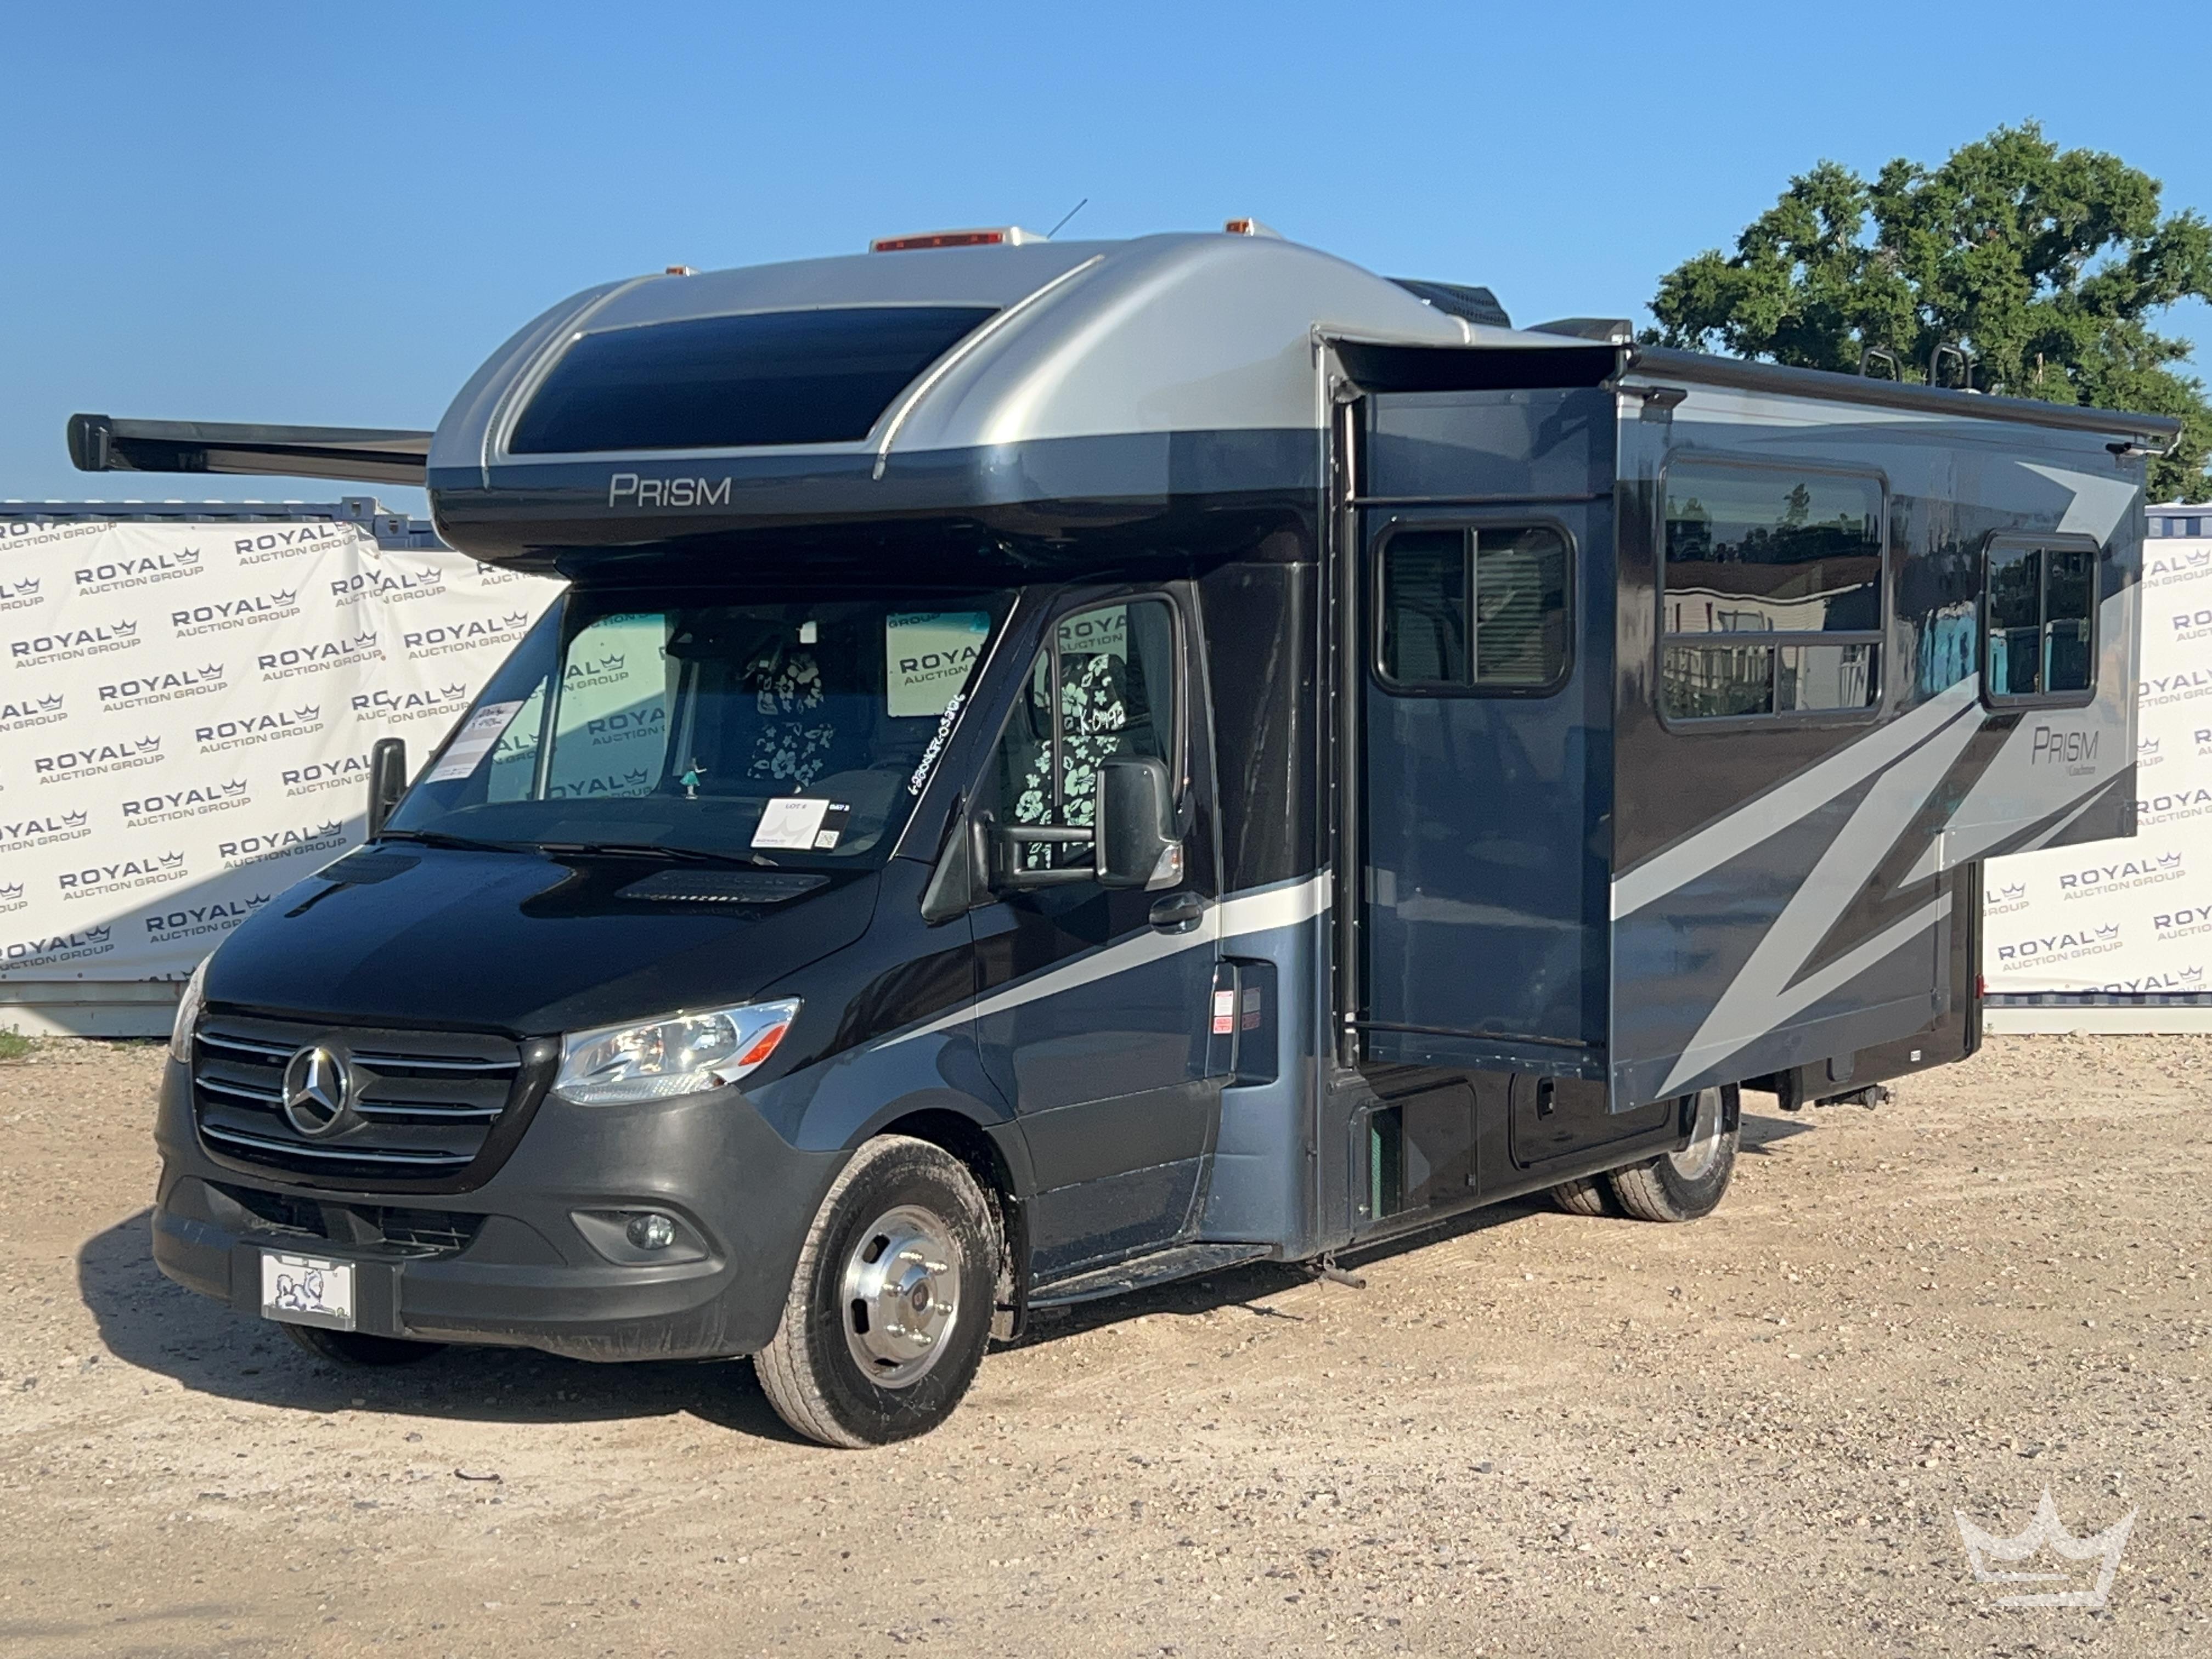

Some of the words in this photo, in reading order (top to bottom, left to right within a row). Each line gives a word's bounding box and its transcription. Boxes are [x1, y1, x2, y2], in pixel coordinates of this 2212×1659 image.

[609, 473, 732, 507] PRISM
[0, 533, 60, 551] UCTION
[64, 522, 117, 539] GROUP
[235, 525, 334, 554] ROYAL
[239, 546, 307, 566] AUCTION
[310, 535, 357, 552] GROUP
[75, 555, 174, 584] ROYAL
[80, 577, 147, 596] AUCTION
[150, 566, 204, 583] GROUP
[331, 569, 416, 596] ROYAL
[481, 572, 525, 586] AUCT
[0, 596, 44, 611] ROUP
[392, 586, 446, 602] GROUP
[172, 597, 271, 627] ROYAL
[177, 618, 244, 638] AUCTION
[247, 607, 300, 624] GROUP
[404, 619, 503, 648] ROYAL
[1058, 614, 1127, 640] ROYA
[12, 628, 112, 657] ROYAL
[16, 649, 84, 669] AUCTION
[87, 639, 140, 655] GROUP
[258, 640, 354, 669] ROYAL
[409, 640, 476, 659] AUCTION
[263, 662, 330, 681] AUCTION
[333, 650, 386, 668] GROUP
[900, 644, 983, 674] ROYA
[99, 672, 199, 701] ROYAL
[577, 672, 629, 689] GROUP
[905, 664, 968, 686] AUCTION
[2138, 672, 2208, 697] OYAL
[103, 692, 171, 712] AUCTION
[174, 682, 228, 698] GROUP
[2138, 693, 2181, 709] CTION
[2183, 686, 2212, 703] GRO
[14, 713, 67, 729] GROUP
[196, 713, 295, 742] ROYAL
[356, 709, 415, 724] AUCION
[588, 708, 665, 735] ROYA
[200, 734, 267, 754] AUCTION
[270, 723, 323, 740] GROUP
[592, 726, 658, 746] AUCTION
[2032, 726, 2099, 765] PRISM
[35, 744, 136, 773] ROYAL
[40, 765, 108, 785] AUCTION
[111, 754, 165, 771] GROUP
[287, 776, 351, 797] AUCTION
[2137, 789, 2212, 813] ROYA
[122, 787, 221, 816] ROYAL
[127, 809, 194, 828] AUCTION
[198, 797, 251, 814] GROUP
[0, 817, 61, 840] YAL
[0, 839, 34, 853] TION
[38, 828, 91, 845] GROUP
[219, 828, 318, 857] ROYAL
[224, 849, 291, 869] AUCTION
[294, 838, 346, 855] GROUP
[59, 859, 159, 889] ROYAL
[64, 881, 131, 900] AUCTION
[134, 870, 188, 887] GROUP
[2060, 860, 2157, 889] ROYAL
[2064, 881, 2130, 901] AUCTION
[2132, 870, 2186, 887] GROUP
[146, 902, 246, 932] ROYAL
[1983, 901, 2030, 916] ROUP
[2153, 905, 2212, 929] ROY
[150, 923, 218, 943] AUCTION
[1999, 932, 2095, 960] ROYAL
[2157, 924, 2212, 941] AUCTIO
[0, 934, 85, 961] OYAL
[0, 956, 57, 971] UCTION
[60, 944, 114, 961] GROUP
[2003, 952, 2068, 972] AUCTION
[2071, 941, 2123, 958] GROUP
